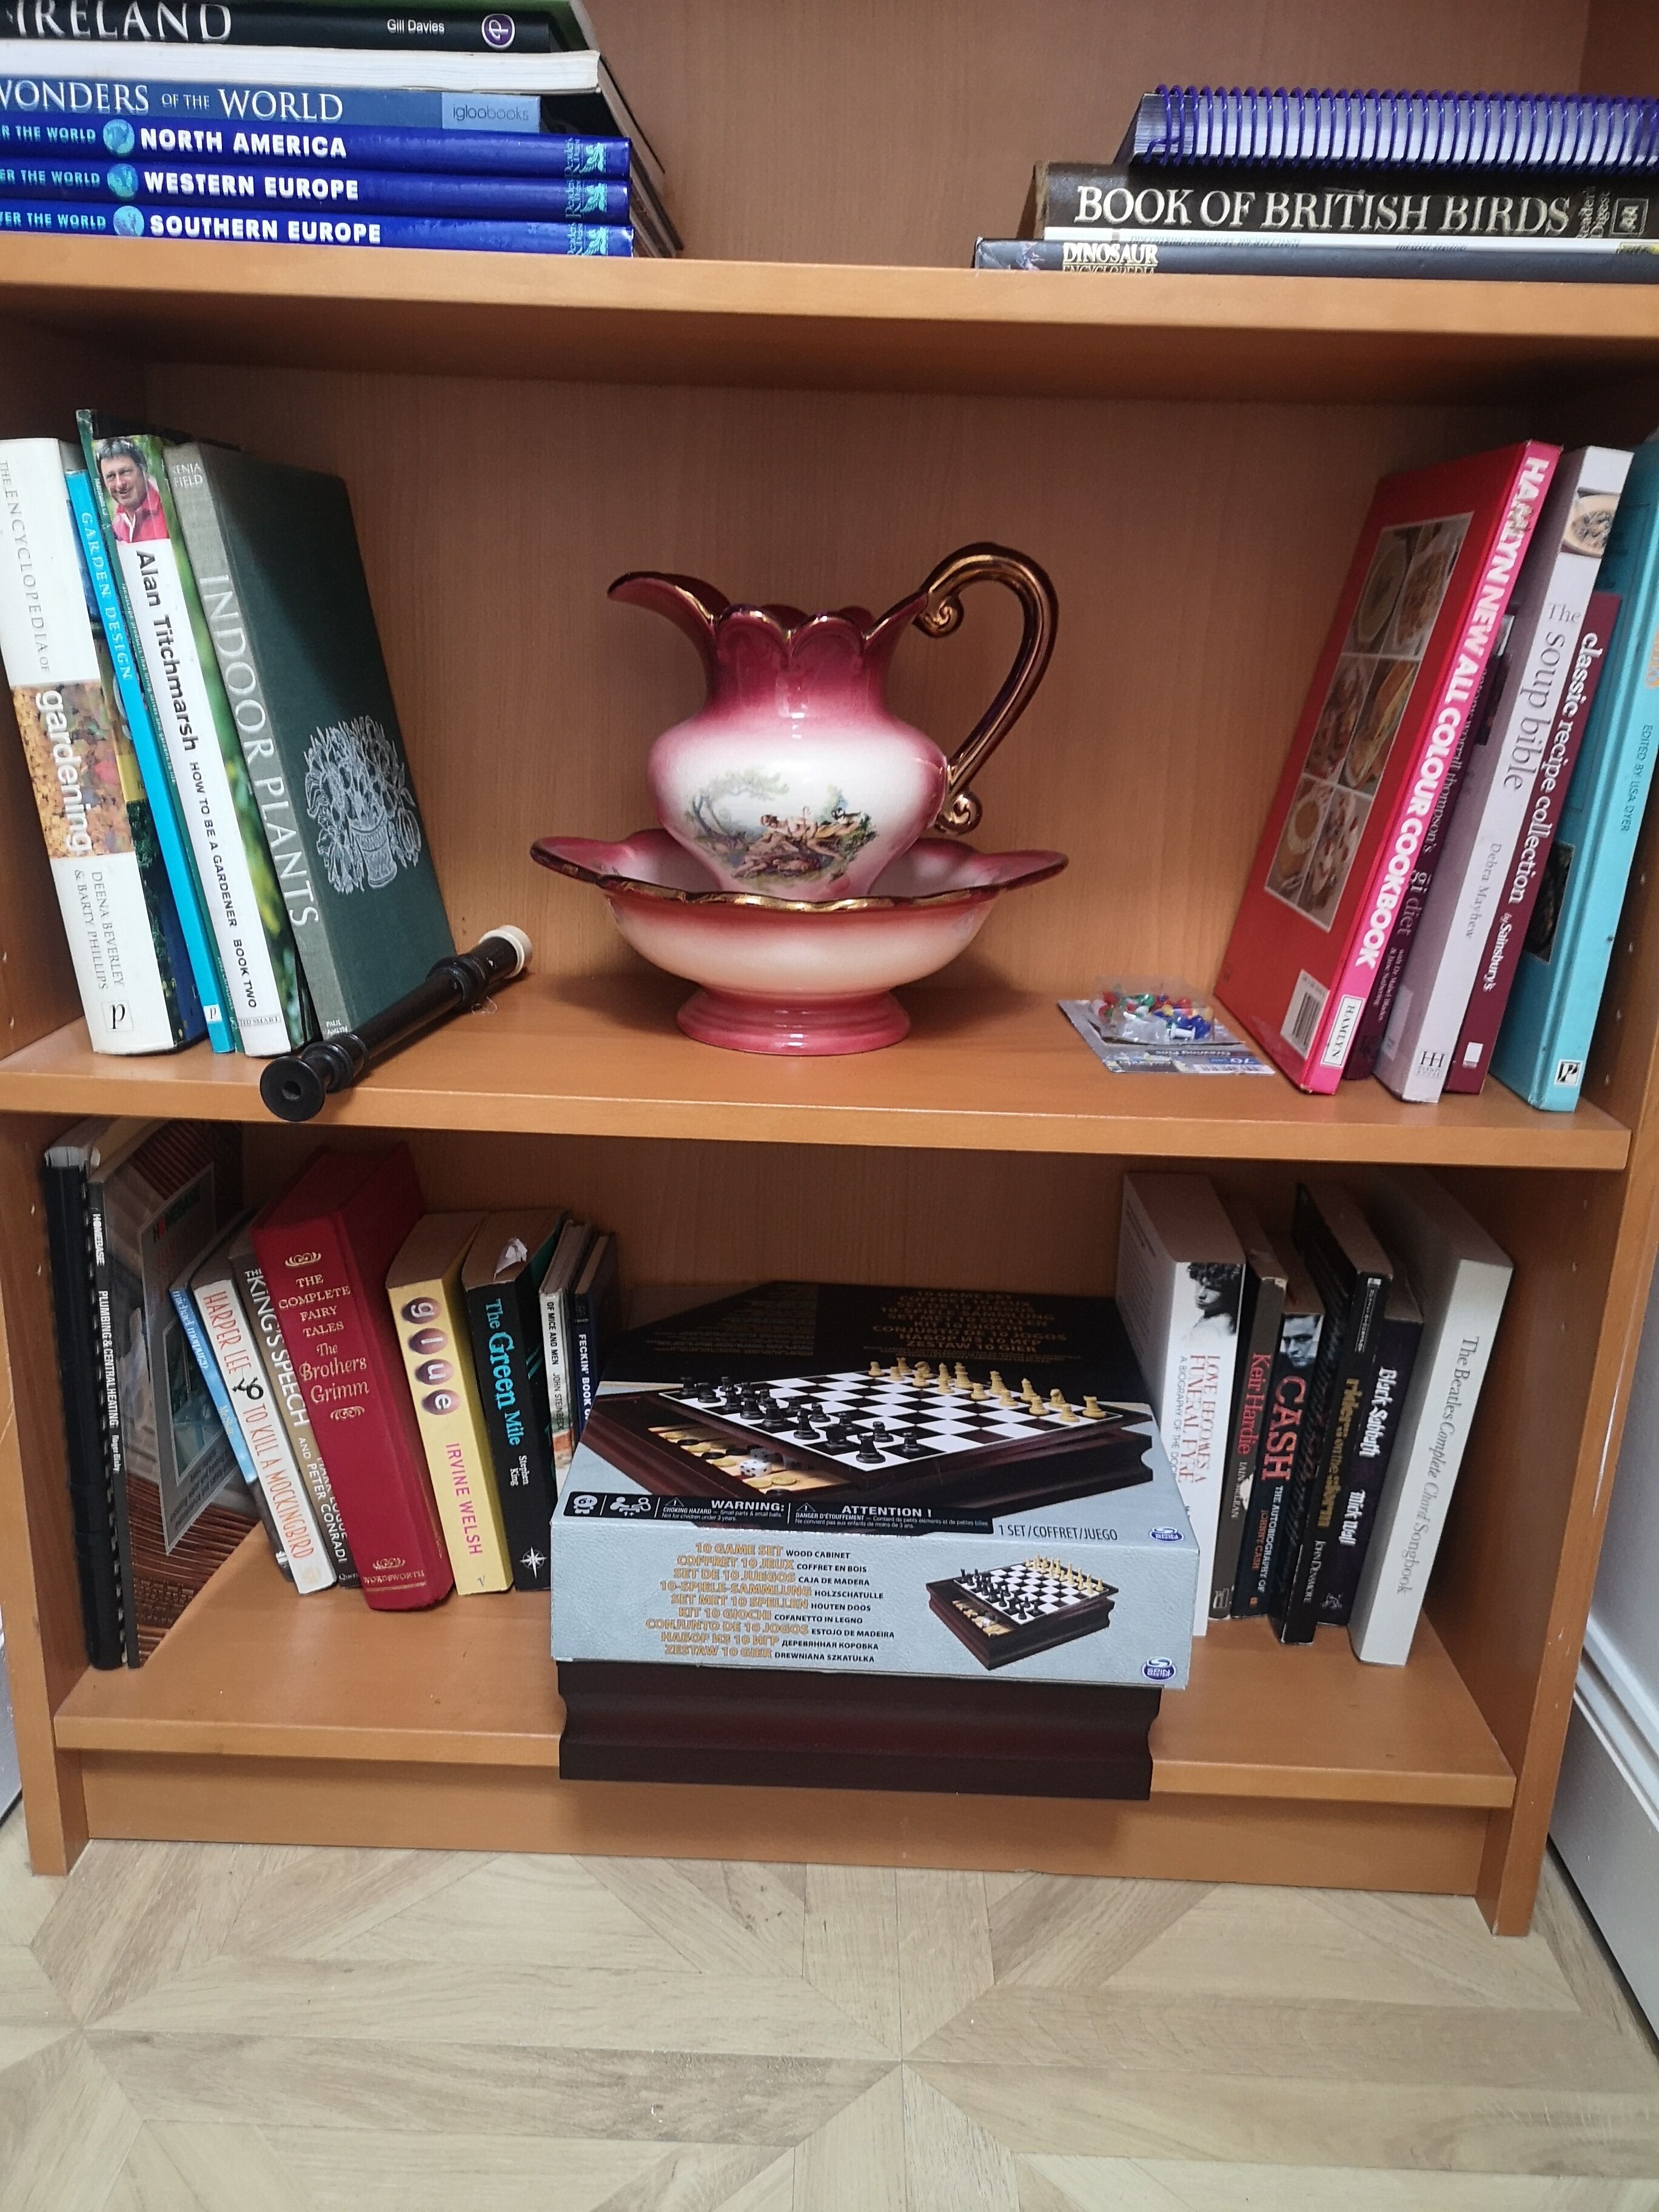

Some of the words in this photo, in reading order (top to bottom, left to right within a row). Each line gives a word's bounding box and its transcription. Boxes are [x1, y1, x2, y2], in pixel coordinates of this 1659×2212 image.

[16, 0, 231, 42] IRELAND
[387, 19, 404, 33] Gill
[407, 19, 444, 35] Davies
[162, 93, 178, 108] OF
[183, 94, 210, 110] THE
[218, 89, 343, 122] WORLD
[452, 104, 529, 121] igloobooks
[16, 126, 40, 141] THE
[47, 127, 96, 143] WORLD
[141, 128, 222, 152] NORTH
[233, 132, 347, 158] AMERICA
[21, 170, 45, 185] THE
[51, 171, 100, 187] WORLD
[144, 171, 254, 197] WESTERN
[265, 176, 358, 200] EUROPE
[27, 213, 52, 229] THE
[57, 214, 106, 230] WORLD
[150, 215, 278, 240] SOUTHERN
[288, 221, 380, 244] EUROPE
[1073, 186, 1193, 226] BOOK
[1199, 190, 1256, 229] OF
[1262, 190, 1431, 234] BRITISH
[1438, 194, 1570, 236] BIRDS
[1062, 242, 1159, 264] DINOSAUR
[0, 461, 12, 484] THE
[173, 475, 203, 488] FIELD
[4, 488, 49, 652] ENCYCLOPEDIA
[79, 510, 113, 598] GARDEN
[104, 605, 134, 680] DESIGN
[1549, 603, 1581, 623] The
[1461, 582, 1506, 658] NEW
[39, 655, 50, 672] OF
[135, 547, 166, 607] Alan
[152, 614, 200, 751] Titchmarsh
[1443, 652, 1482, 710] ALL
[1520, 627, 1566, 711] soup
[1560, 631, 1607, 721] classic
[195, 570, 279, 766] INDOOR
[251, 773, 322, 929] PLANTS
[1502, 711, 1550, 796] bible
[1533, 717, 1579, 797] recipe
[1635, 723, 1654, 760] EDITED
[34, 687, 99, 854] gardening
[189, 760, 206, 795] HOW
[1406, 703, 1463, 820] COLOUR
[1632, 763, 1644, 777] BY
[198, 797, 210, 816] TO
[1619, 804, 1634, 832] DYER
[203, 818, 216, 838] BE
[209, 840, 220, 851] A
[1481, 841, 1503, 883] Debra
[1504, 794, 1560, 909] collection
[211, 853, 239, 928] GARDENER
[1353, 814, 1426, 973] COOKBOOK
[91, 870, 110, 917] DEENA
[101, 920, 126, 987] BEVERLEY
[1396, 896, 1424, 938] diet
[1461, 883, 1490, 940] Mayhew
[87, 929, 109, 990] PHILLIPS
[232, 937, 250, 977] BOOK
[1479, 921, 1513, 994] Sainsbury's
[243, 979, 257, 1008] TWO
[252, 1016, 279, 1025] SMART
[1330, 1004, 1356, 1058] HAMLYN
[90, 1213, 106, 1266] HOMEBASE
[279, 1285, 350, 1309] COMPLETE
[295, 1273, 324, 1289] THE
[96, 1290, 113, 1339] PLUMBING
[203, 1290, 244, 1350] HARPER
[299, 1304, 338, 1322] FAIRY
[301, 1319, 344, 1338] TALES
[483, 1298, 506, 1330] The
[546, 1312, 556, 1330] MICE
[315, 1340, 339, 1357] The
[409, 1299, 458, 1412] glue
[548, 1332, 558, 1347] AND
[549, 1349, 560, 1365] MEN
[577, 1333, 589, 1374] FECKIN'
[1456, 1332, 1481, 1368] The
[102, 1347, 118, 1389] CENTRAL
[223, 1348, 253, 1375] LEE
[297, 1350, 368, 1382] Brothers
[481, 1330, 526, 1410] Green
[1203, 1355, 1220, 1394] LOVE
[1246, 1351, 1272, 1393] Keir
[268, 1347, 310, 1428] SPEECH
[309, 1375, 370, 1406] Grimm
[552, 1372, 562, 1392] JOHN
[581, 1376, 592, 1407] BOOK
[1174, 1365, 1187, 1416] BIOGRAPHY
[1182, 1353, 1205, 1434] FUNERAL
[1370, 1366, 1399, 1409] Black
[1442, 1366, 1472, 1423] Beatles
[104, 1387, 121, 1429] HEATING
[241, 1403, 269, 1425] TO
[554, 1393, 565, 1430] STEINBECK
[1236, 1392, 1265, 1458] Hardie
[249, 1424, 280, 1457] KILL
[502, 1409, 527, 1446] Mile
[1196, 1399, 1216, 1469] BECOMES
[1260, 1373, 1308, 1485] CASH
[1357, 1405, 1390, 1460] Sabbath
[1178, 1438, 1198, 1484] PYRE
[1421, 1418, 1456, 1480] Complete
[444, 1441, 471, 1498] IRVINE
[506, 1466, 521, 1487] King
[515, 1454, 532, 1486] Stephen
[1236, 1461, 1247, 1481] IAIN
[297, 1436, 312, 1460] AND
[306, 1462, 327, 1500] PETER
[318, 1502, 348, 1564] CONRADI
[711, 1499, 785, 1512] WARNING:
[842, 1504, 922, 1518] ATTENTION
[1272, 1484, 1283, 1504] THE
[1343, 1486, 1367, 1521] Mick
[1415, 1480, 1440, 1523] Chord
[264, 1467, 317, 1561] MOCKINGBIRD
[457, 1500, 483, 1556] WELSH
[1255, 1509, 1269, 1544] JOHNNY
[1259, 1503, 1280, 1578] AUTOBIOGRAPHY
[1336, 1518, 1361, 1547] Wall
[677, 1553, 739, 1567] COFFRET
[760, 1558, 795, 1570] JEUX
[796, 1563, 833, 1571] COFFRET
[714, 1543, 756, 1555] GAME
[814, 1550, 851, 1560] CABINET
[1250, 1544, 1263, 1570] CASH
[1391, 1519, 1430, 1597] Songbook
[740, 1569, 797, 1583] JUEGOS
[834, 1577, 870, 1586] MADERA
[814, 1589, 884, 1600] HOLZSCHATULLE
[1257, 1578, 1267, 1593] OF
[723, 1607, 773, 1621] GIOCHI
[774, 1612, 823, 1622] COFANETTO
[749, 1595, 809, 1610] SPELLEN
[811, 1601, 846, 1610] HOUTEN
[645, 1617, 725, 1632] CONJUNTO
[660, 1631, 711, 1644] НАБОР
[839, 1641, 879, 1651] КОРОБКА
[664, 1643, 720, 1657] ZESTAW
